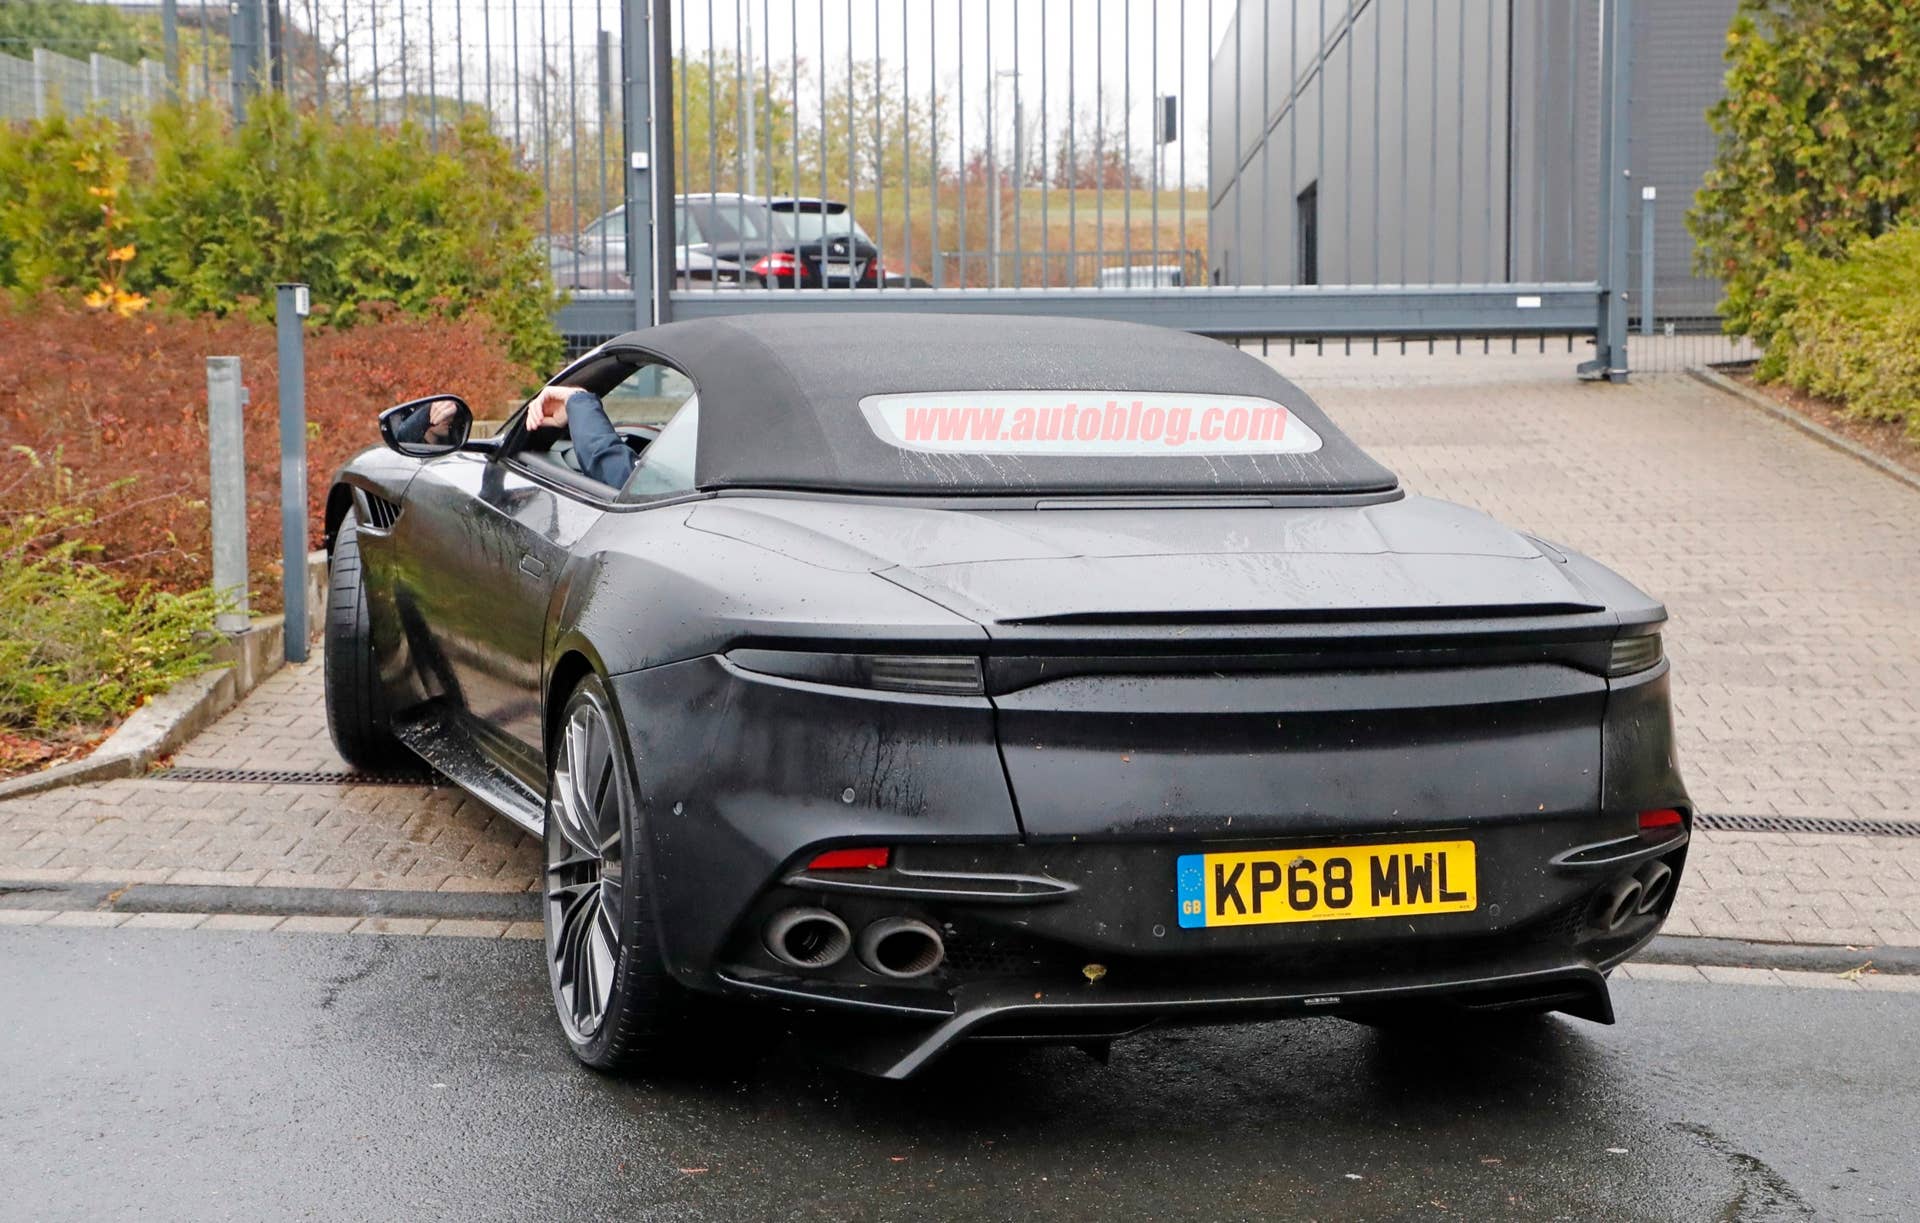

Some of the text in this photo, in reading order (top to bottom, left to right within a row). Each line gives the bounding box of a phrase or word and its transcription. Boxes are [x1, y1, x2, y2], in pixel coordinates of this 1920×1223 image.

[1214, 852, 1468, 916] KP68 MWL
[1182, 900, 1202, 915] GB
